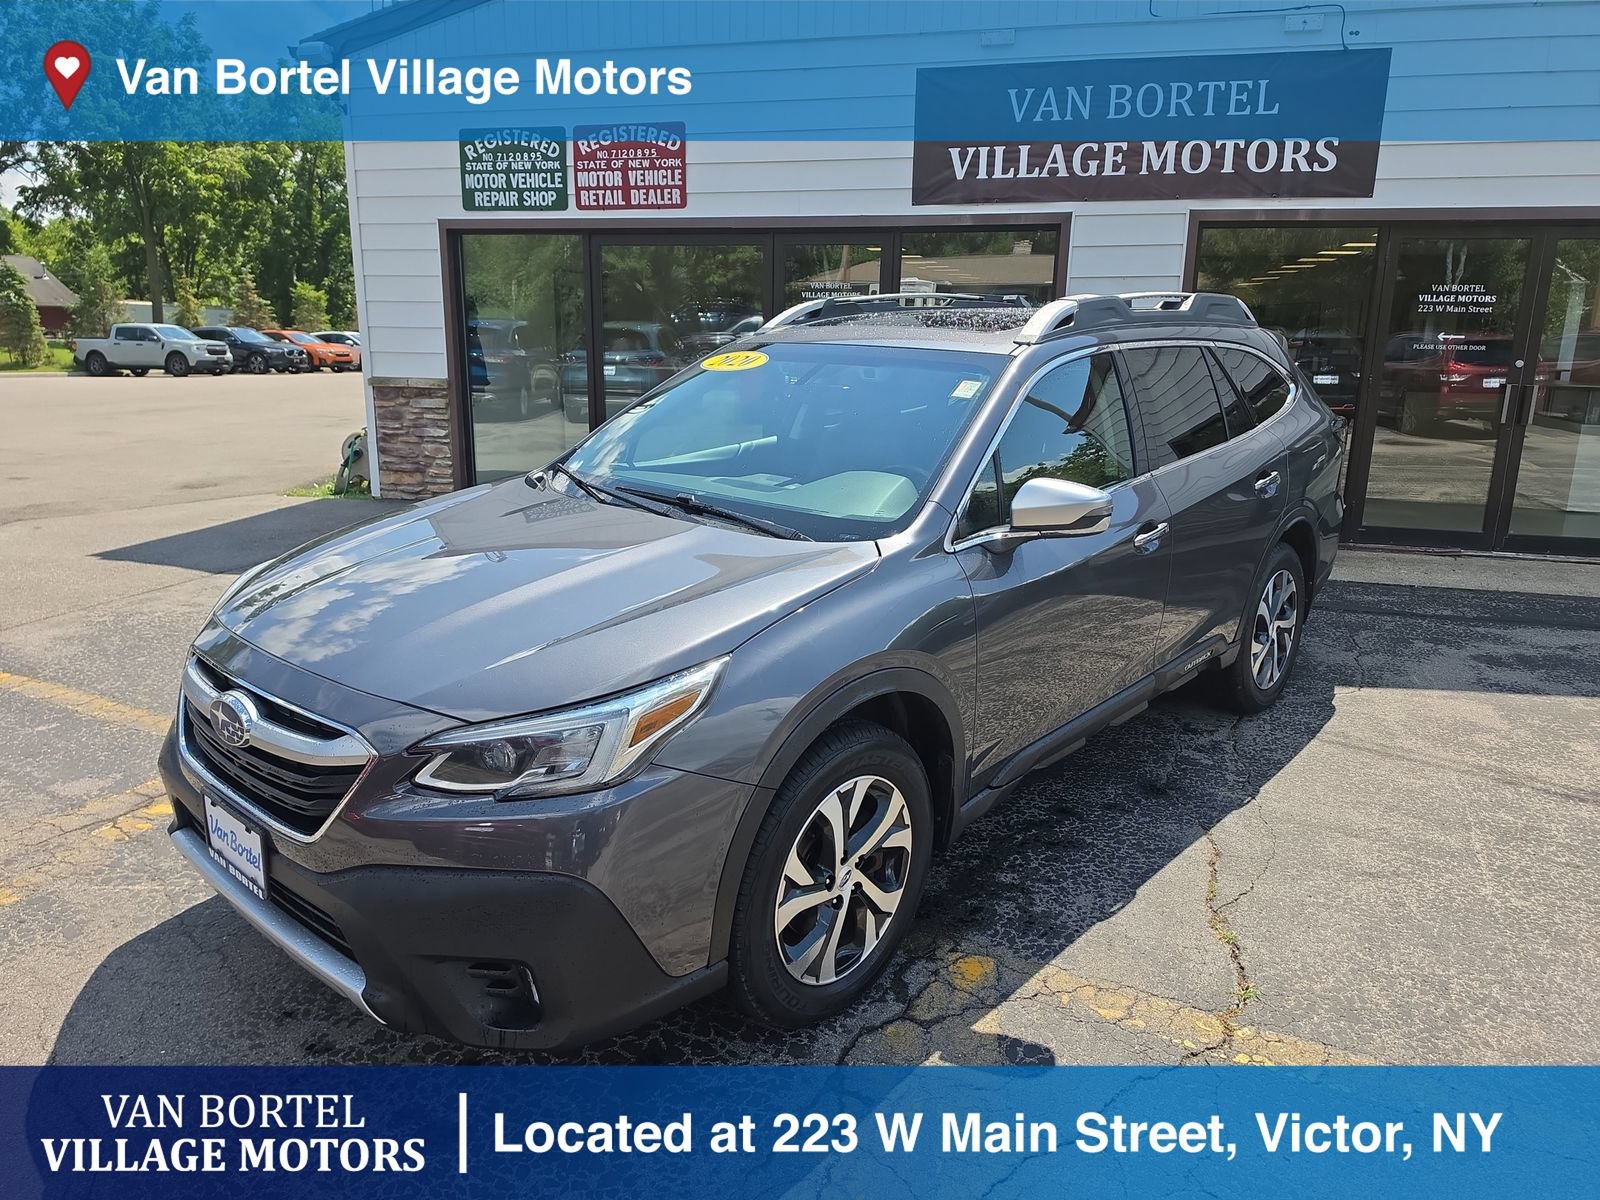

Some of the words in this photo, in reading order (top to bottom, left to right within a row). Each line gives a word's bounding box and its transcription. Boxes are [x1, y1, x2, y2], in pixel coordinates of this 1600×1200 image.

[1008, 86, 1094, 123] VAN
[1106, 79, 1281, 119] BORTEL
[464, 129, 560, 161] REGISTERED
[577, 125, 681, 155] REGISTERED
[497, 151, 543, 161] 7120895
[611, 148, 657, 158] 7120895
[948, 141, 1128, 181] VILLAGE
[1138, 137, 1340, 176] MOTORS
[465, 162, 493, 171] STATE
[496, 162, 509, 170] OF
[511, 161, 532, 170] NEW
[535, 160, 561, 169] YORK
[576, 160, 607, 169] STATE
[611, 159, 625, 168] OF
[628, 159, 650, 168] NEW
[654, 158, 682, 167] YORK
[464, 173, 507, 189] MOTOR
[509, 172, 563, 189] VEHICLE
[576, 170, 622, 187] MOTOR
[628, 169, 683, 186] VEHICLE
[474, 191, 519, 207] REPAIR
[522, 190, 557, 206] SHOP
[580, 189, 626, 206] RETAIL
[630, 188, 681, 205] DEALER
[1431, 284, 1450, 292] VAN
[1451, 284, 1486, 292] BORTEL
[1418, 294, 1456, 303] VILLAGE
[1457, 294, 1497, 303] MOTORS
[1446, 305, 1466, 313] Main
[1467, 305, 1493, 313] Street
[208, 813, 230, 847] Van
[229, 830, 262, 872] Bortel
[208, 847, 227, 868] VAN
[228, 864, 265, 900] BORTEL
